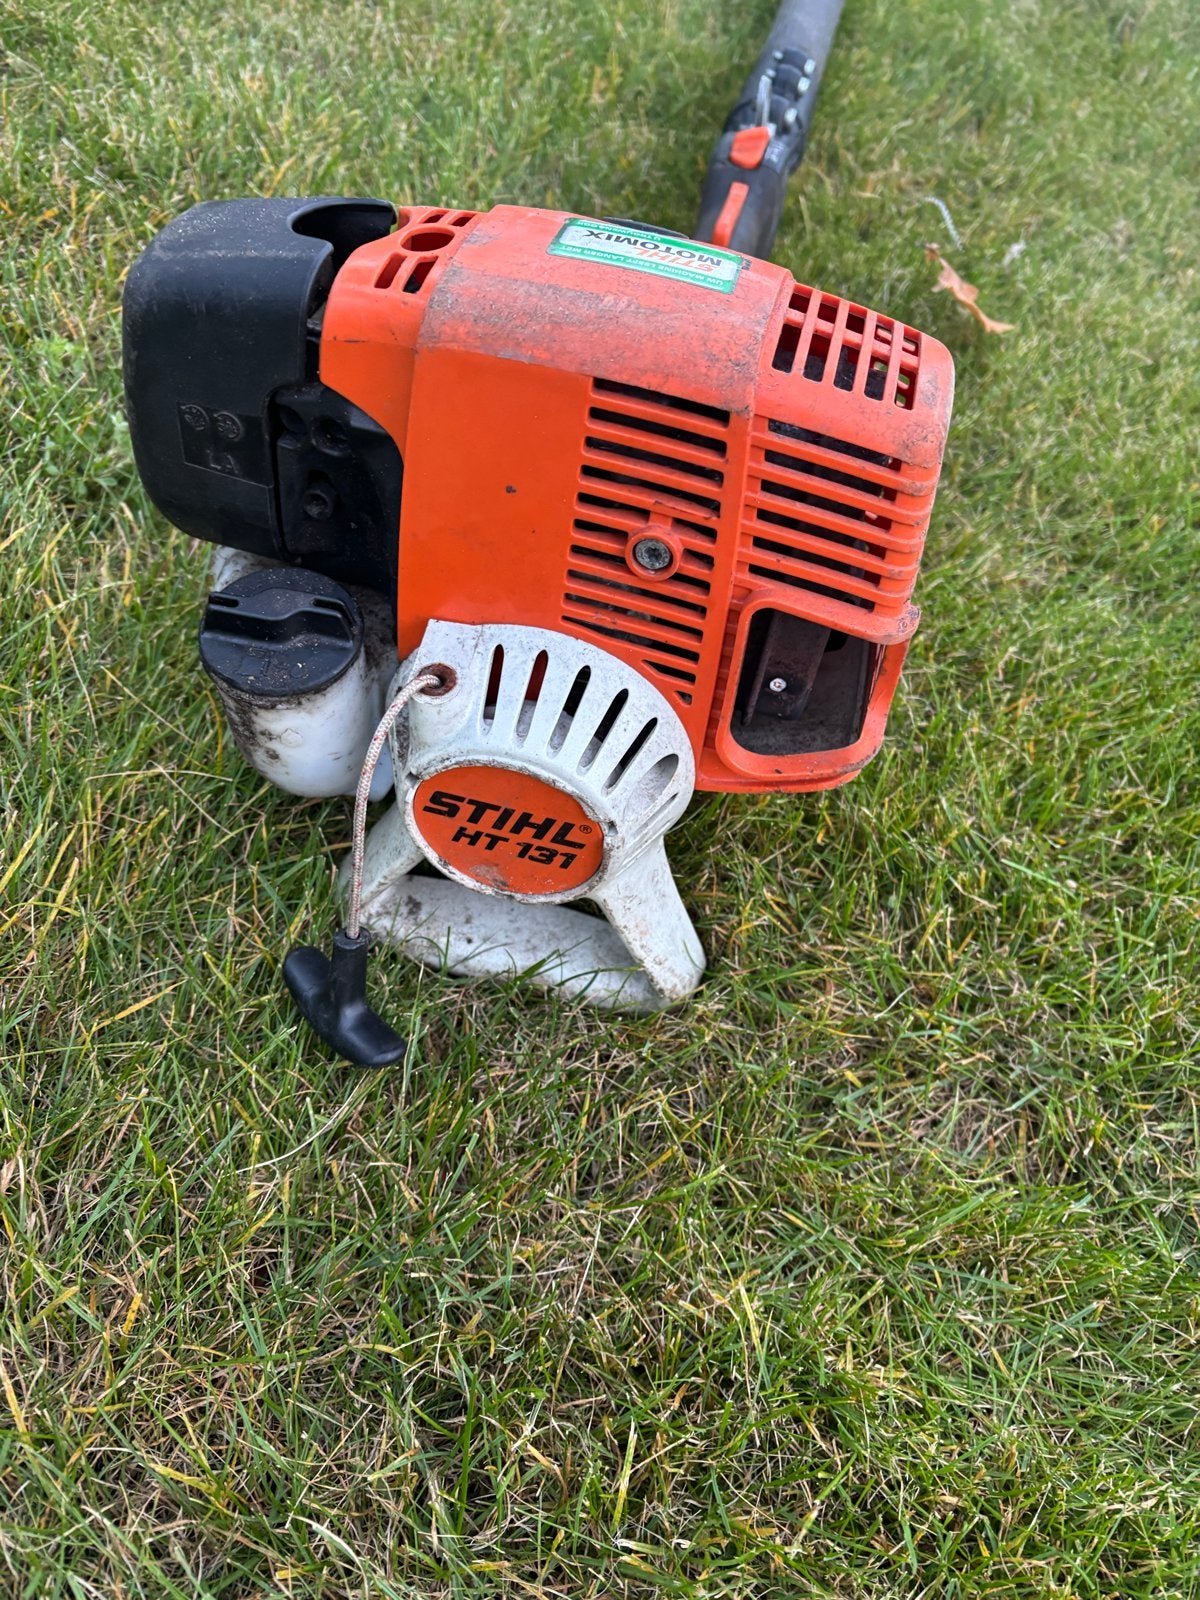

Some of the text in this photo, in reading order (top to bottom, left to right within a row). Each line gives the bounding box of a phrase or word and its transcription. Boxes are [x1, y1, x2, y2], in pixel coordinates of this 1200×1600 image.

[560, 244, 582, 253] MET
[583, 229, 723, 267] MOTOMIX
[633, 247, 718, 272] STIHL
[657, 265, 705, 281] MACHINE
[422, 790, 586, 850] STIHL
[451, 826, 578, 870] HT 131
